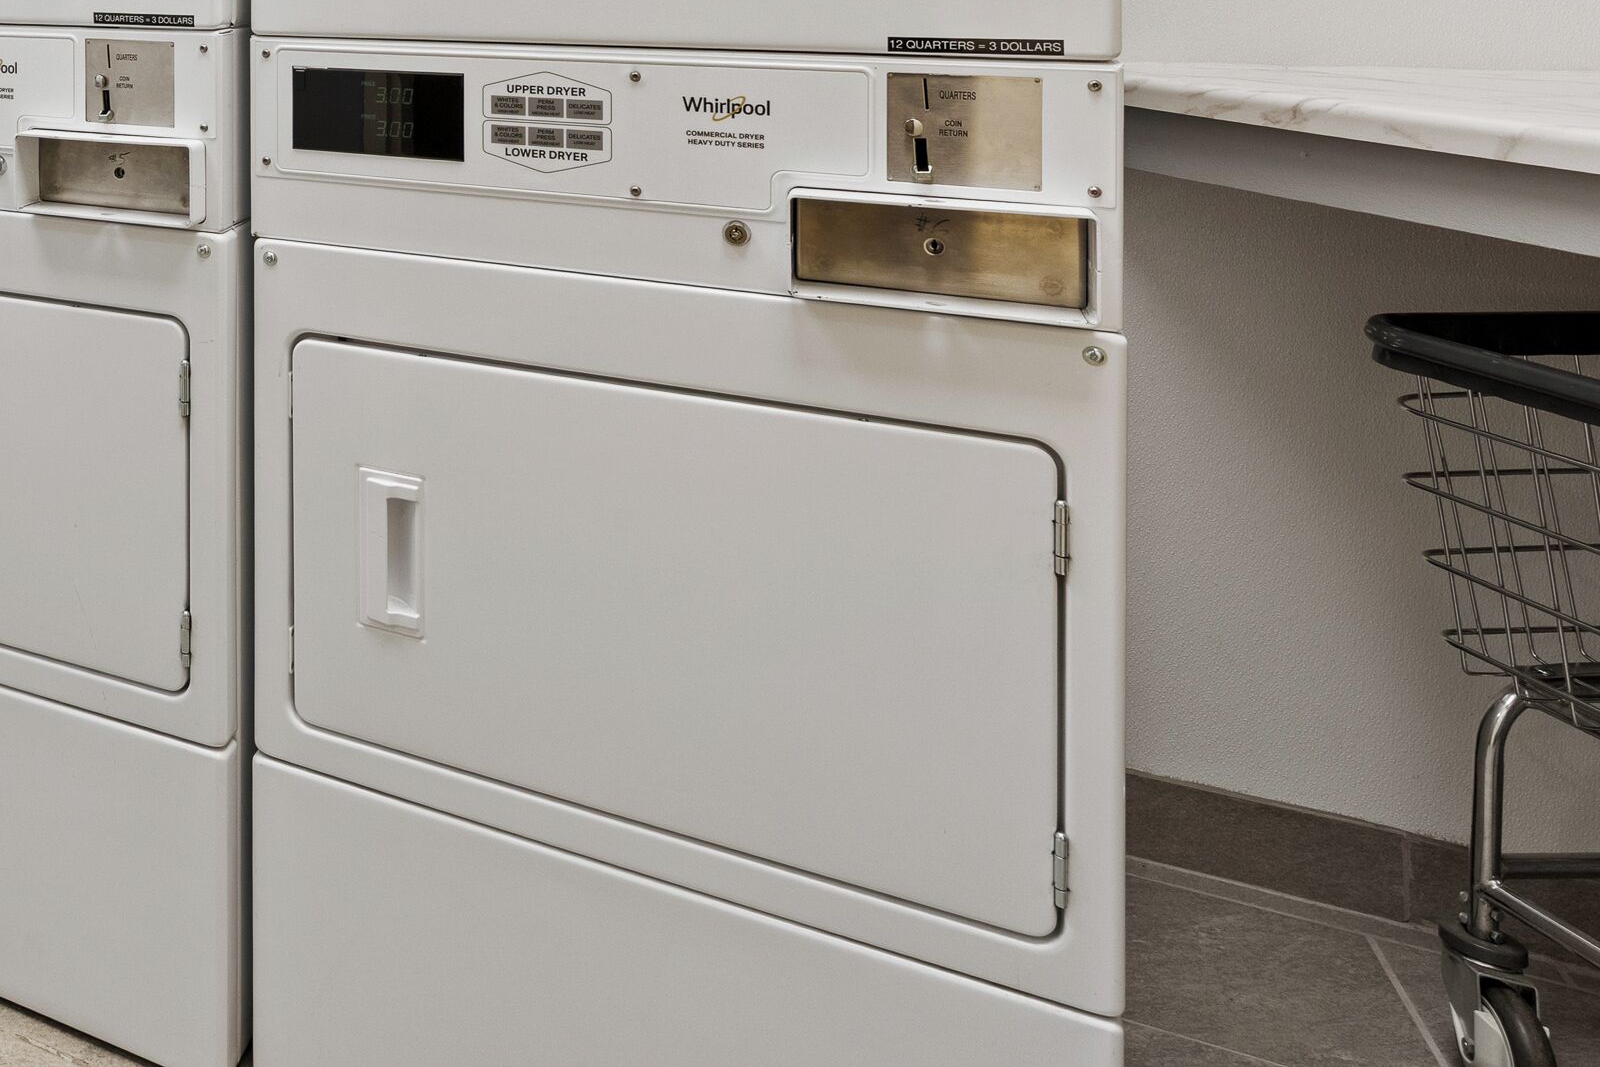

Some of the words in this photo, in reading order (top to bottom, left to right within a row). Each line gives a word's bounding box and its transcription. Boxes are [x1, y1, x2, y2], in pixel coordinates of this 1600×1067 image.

[104, 15, 144, 23] QUARTERS
[889, 40, 903, 49] 12
[906, 40, 975, 51] QUARTERS
[989, 41, 996, 50] 3
[1001, 42, 1061, 52] DOLLARS
[376, 87, 413, 104] 3.00
[507, 84, 544, 94] UPPER
[547, 86, 586, 96] DRYER
[939, 90, 976, 100] QUARTERS
[682, 96, 770, 118] Whirlpool
[376, 121, 414, 138] 3.00
[686, 130, 737, 138] COMMERCIAL
[939, 129, 968, 137] RETURN
[505, 147, 546, 158] LOWER
[549, 150, 588, 161] DRYER
